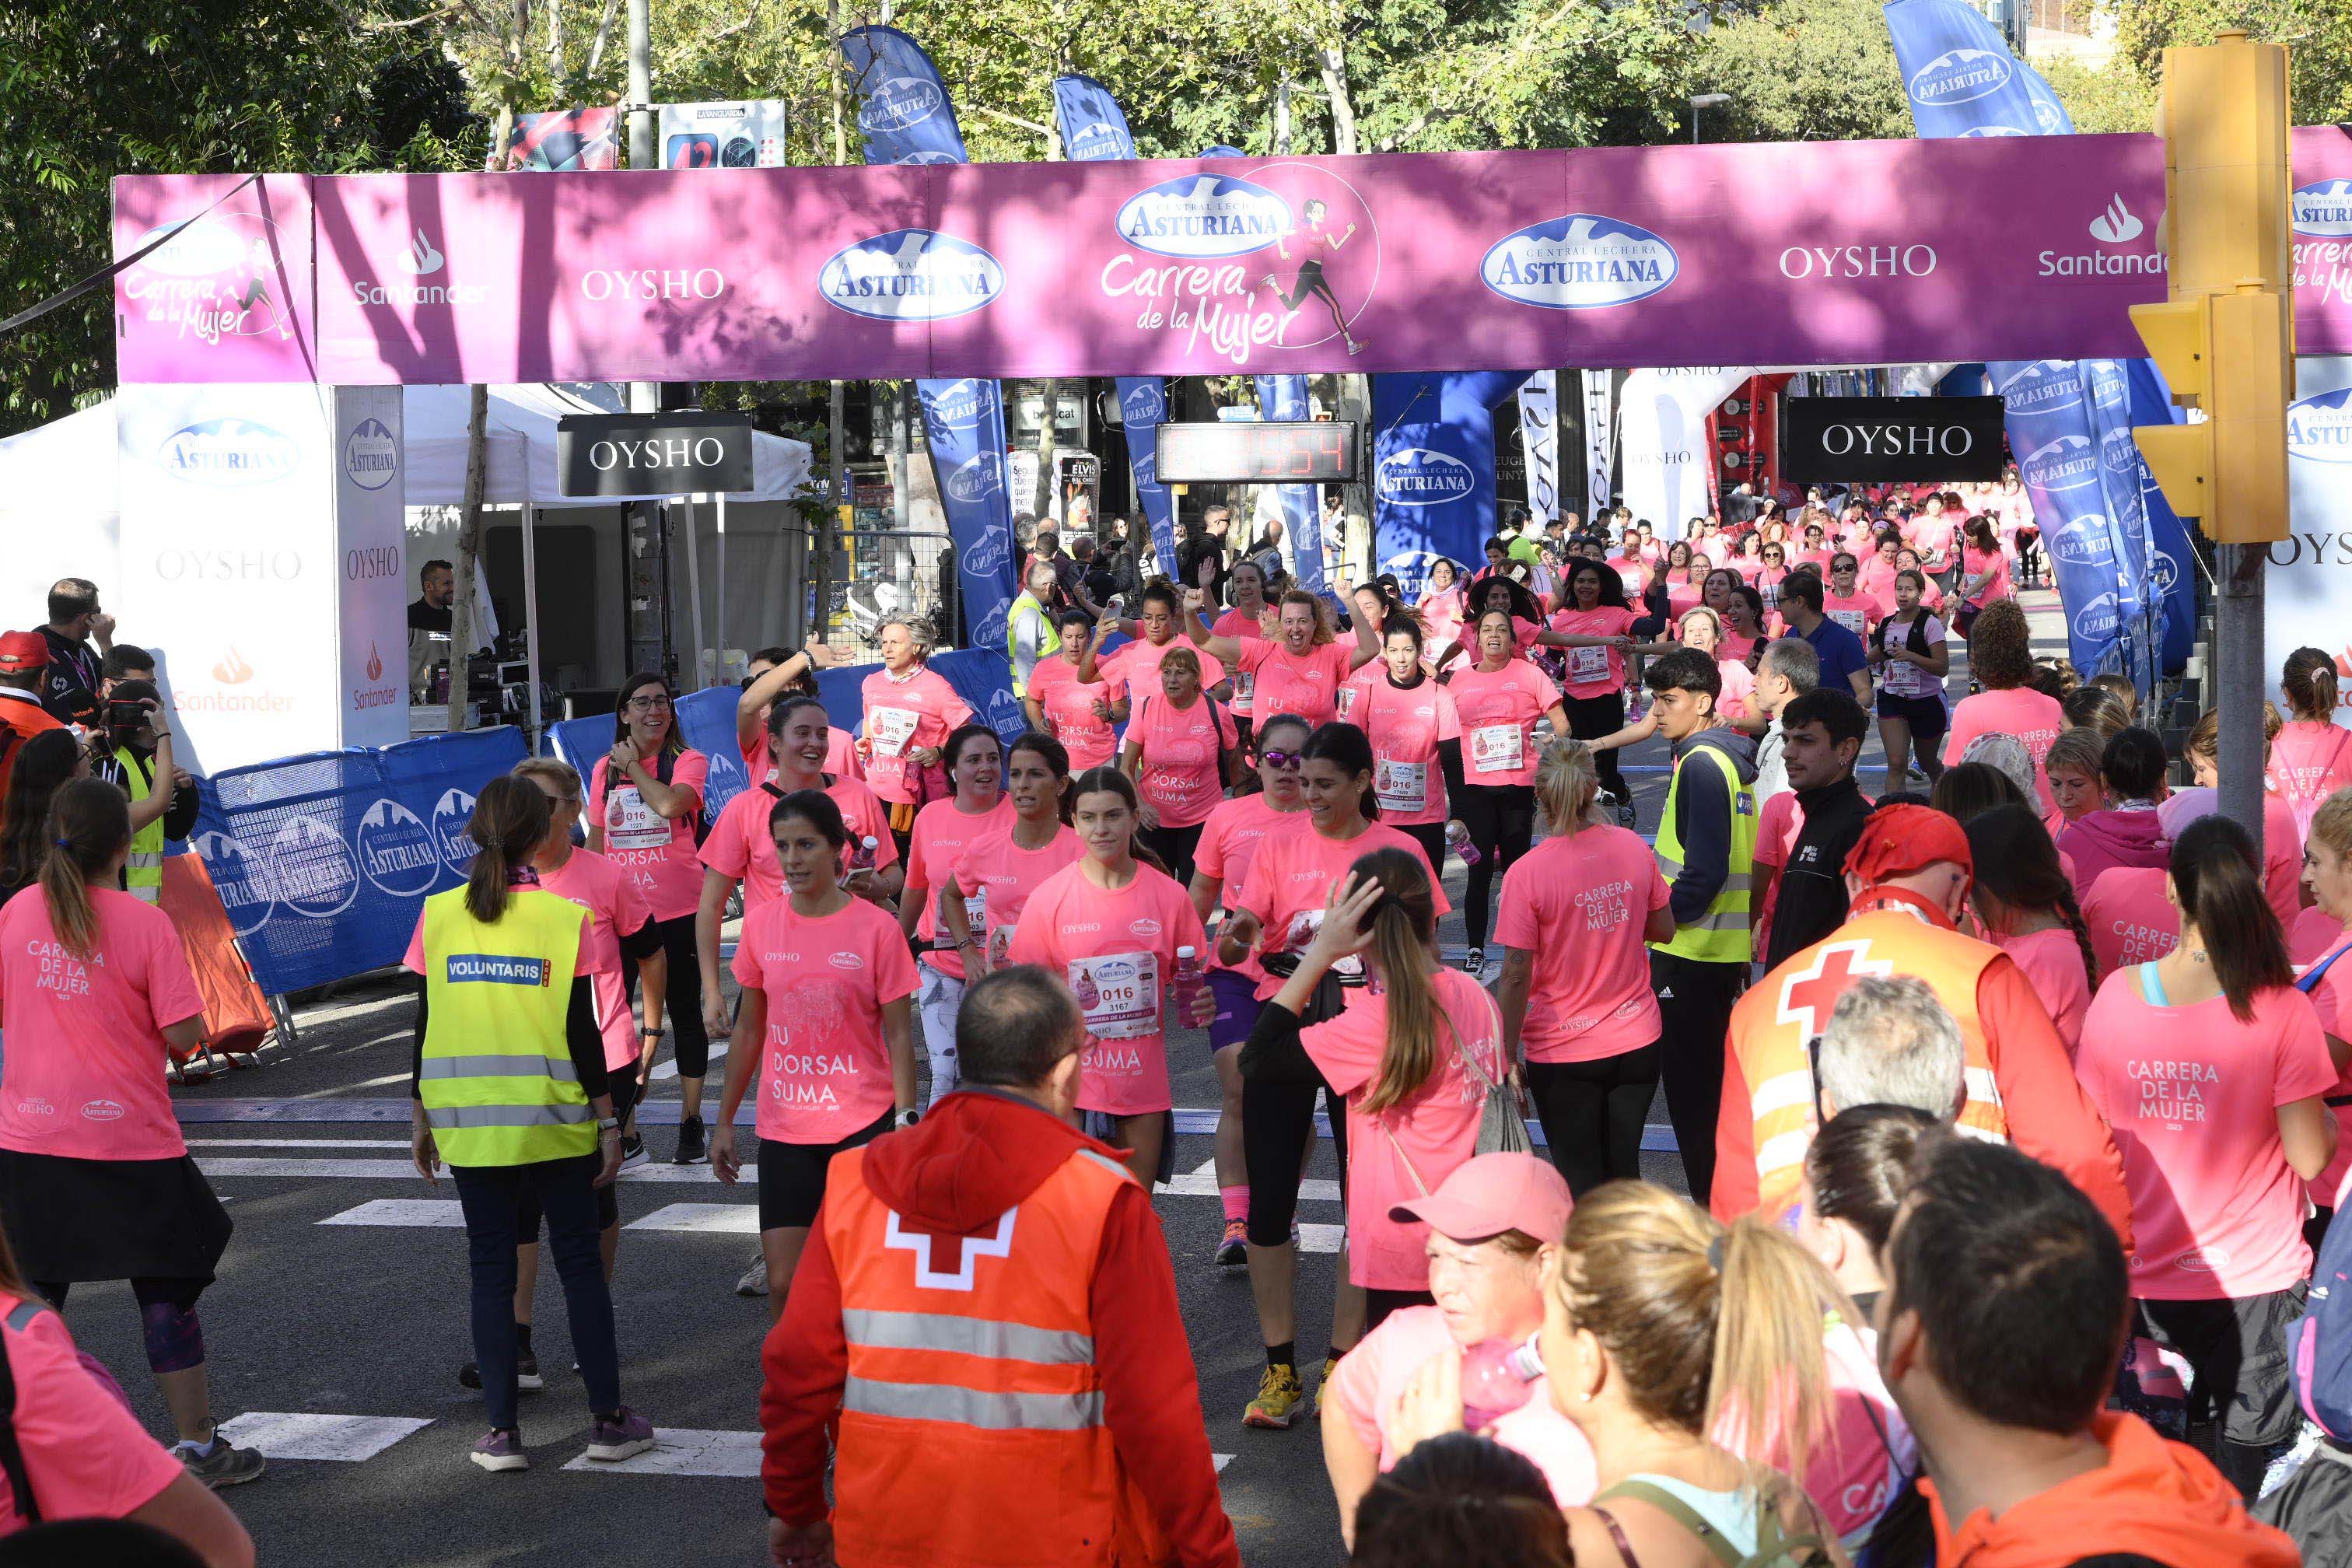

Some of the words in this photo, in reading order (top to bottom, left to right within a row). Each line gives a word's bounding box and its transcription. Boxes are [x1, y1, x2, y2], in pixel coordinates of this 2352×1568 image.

[705, 110, 744, 118] VANGUARDIA
[1129, 205, 1278, 237] ASTURIANA
[1526, 247, 1589, 258] CENTRAL
[1595, 245, 1657, 257] LECHERA
[1780, 244, 1937, 279] OYSHO
[1101, 254, 1246, 297] Carrera
[1496, 250, 1664, 287] ASTURIANA
[353, 278, 488, 306] Santander
[582, 268, 725, 300] OYSHO
[178, 298, 251, 345] Mujer
[1136, 299, 1164, 330] de
[1169, 298, 1189, 329] la
[1186, 292, 1300, 365] Mujer
[1822, 424, 1972, 456] OYSHO
[349, 443, 394, 472] ASTURIANA
[589, 437, 724, 471] OYSHO
[1072, 465, 1096, 475] ELVIS
[1389, 467, 1422, 476] CENTRAL
[1425, 467, 1463, 475] LECHERA
[1380, 471, 1467, 494] ASTURIANA
[156, 548, 302, 581] OYSHO
[348, 545, 398, 580] OYSHO
[173, 689, 293, 712] Santander
[354, 686, 397, 712] Santander
[1268, 697, 1283, 709] TU
[886, 726, 900, 734] 016
[2018, 728, 2056, 743] ARRERA
[1377, 749, 1391, 760] TU
[1489, 742, 1506, 751] 016
[877, 761, 901, 773] UMA
[1150, 762, 1165, 772] TU
[1152, 774, 1200, 789] DORSAL
[1393, 780, 1411, 789] 016
[1151, 786, 1187, 803] SUMA
[626, 811, 646, 821] 016
[372, 833, 398, 846] CENTRAL
[397, 827, 425, 841] LECHERA
[369, 838, 437, 877] ASTURIANA
[987, 875, 1017, 885] OYSHO
[1292, 870, 1325, 883] OYSHO
[1574, 879, 1633, 908] CARRERA
[968, 912, 984, 922] 16
[1587, 902, 1605, 919] DE
[1608, 898, 1625, 912] LA
[1062, 922, 1101, 934] OYSHO
[1587, 908, 1629, 933] MUJER
[2112, 920, 2179, 950] CARRER
[765, 952, 800, 962] OYSHO
[2123, 939, 2146, 955] DE
[40, 957, 62, 975] DE
[66, 961, 87, 978] LA
[449, 961, 539, 979] VOLUNTARIS
[1098, 969, 1132, 978] ASTURIANA
[37, 975, 90, 996] MUJER
[1102, 986, 1133, 1001] 016
[1109, 1003, 1129, 1012] 3167
[772, 1024, 789, 1046] TU
[1559, 1019, 1598, 1032] OYSHO
[774, 1052, 859, 1076] DORSAL
[2128, 1059, 2219, 1083] CARRERA
[772, 1079, 837, 1104] SUMA
[2142, 1080, 2168, 1100] DE
[2177, 1082, 2202, 1101] LA
[18, 1103, 54, 1115] OYSHO
[85, 1106, 121, 1116] ASTURIANA
[2139, 1101, 2206, 1122] MUJER
